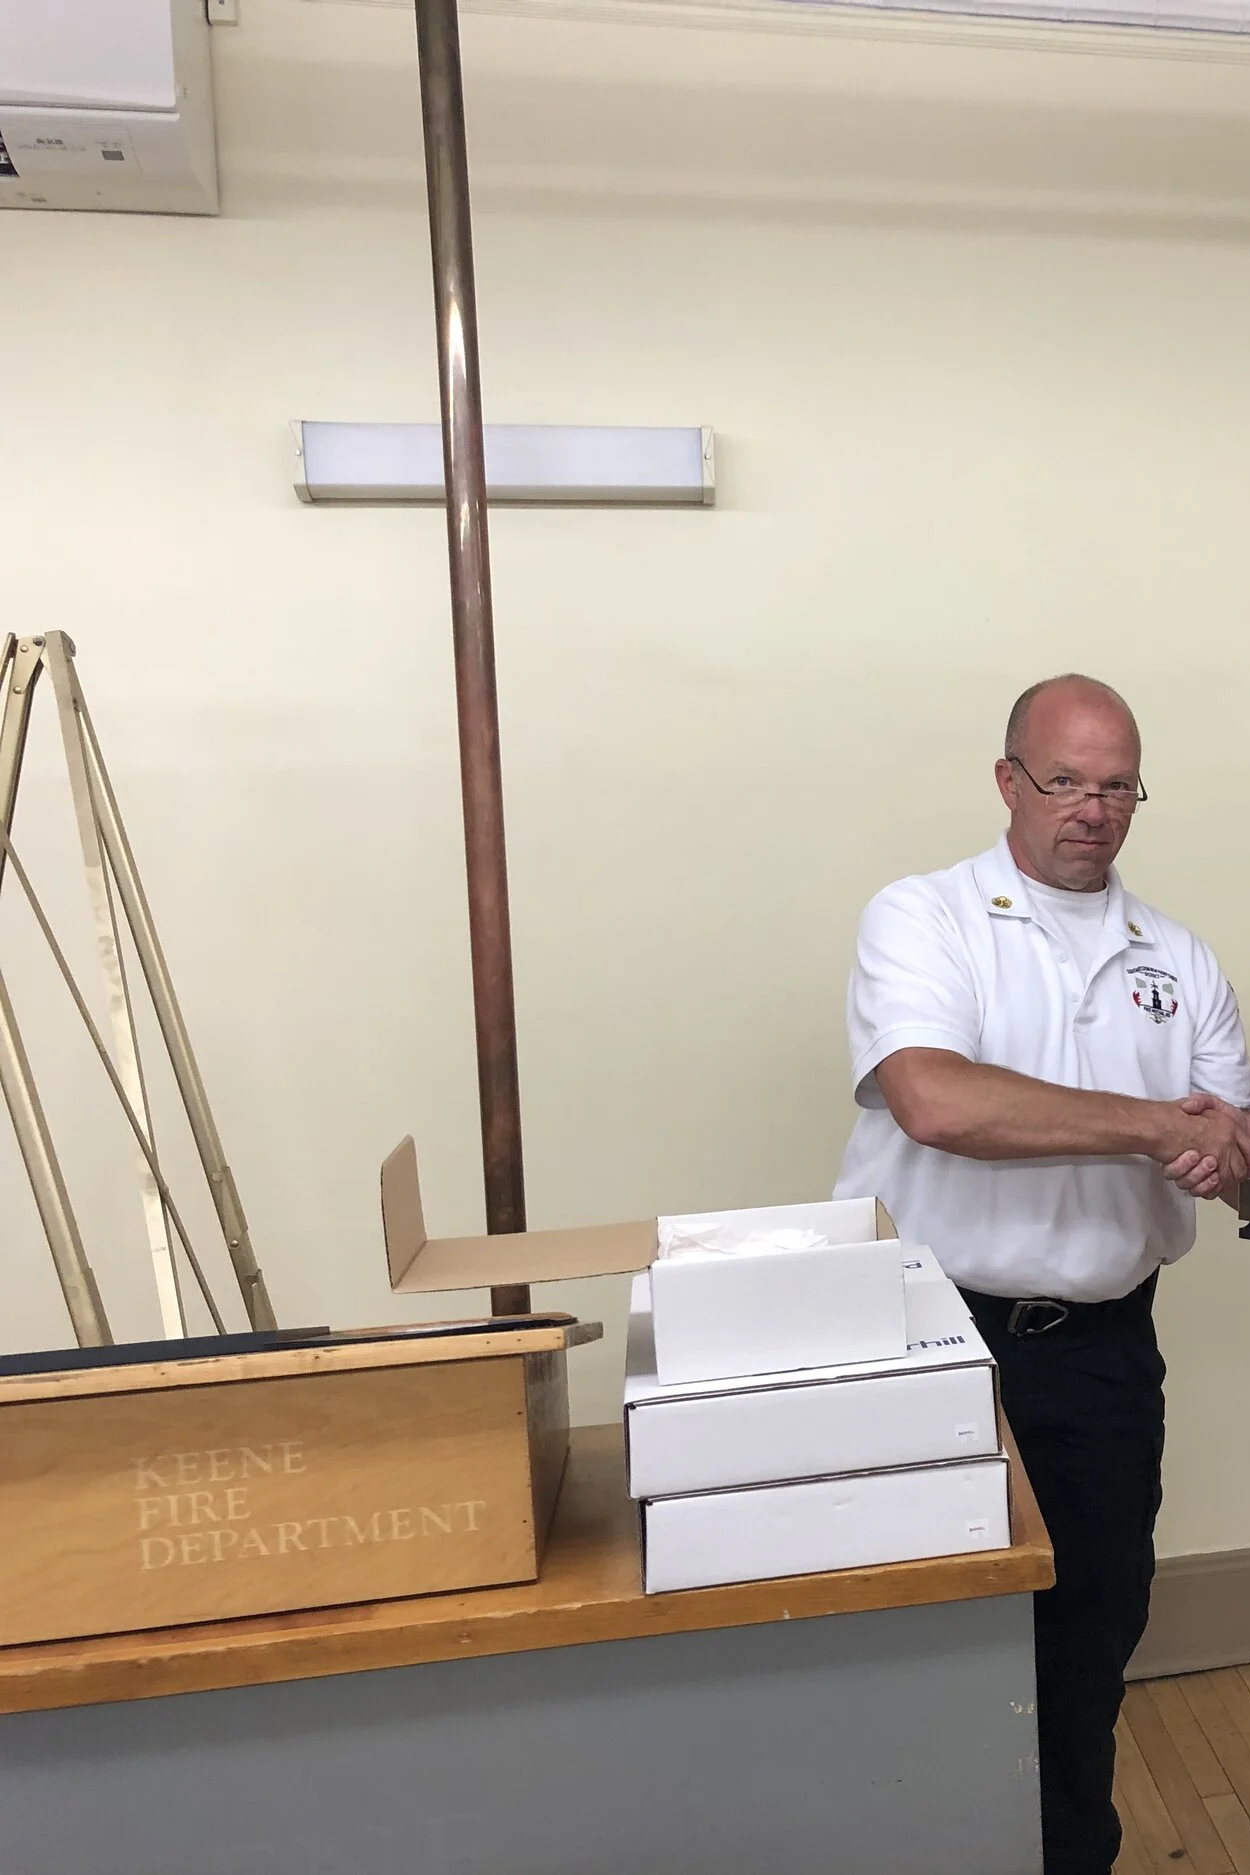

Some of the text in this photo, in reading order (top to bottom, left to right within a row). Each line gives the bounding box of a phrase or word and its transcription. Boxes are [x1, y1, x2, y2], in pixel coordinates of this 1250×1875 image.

[906, 1335, 966, 1351] rhill
[132, 1441, 308, 1490] KEENE
[136, 1487, 252, 1531] FIRE
[138, 1500, 487, 1571] DEPARTMENT
